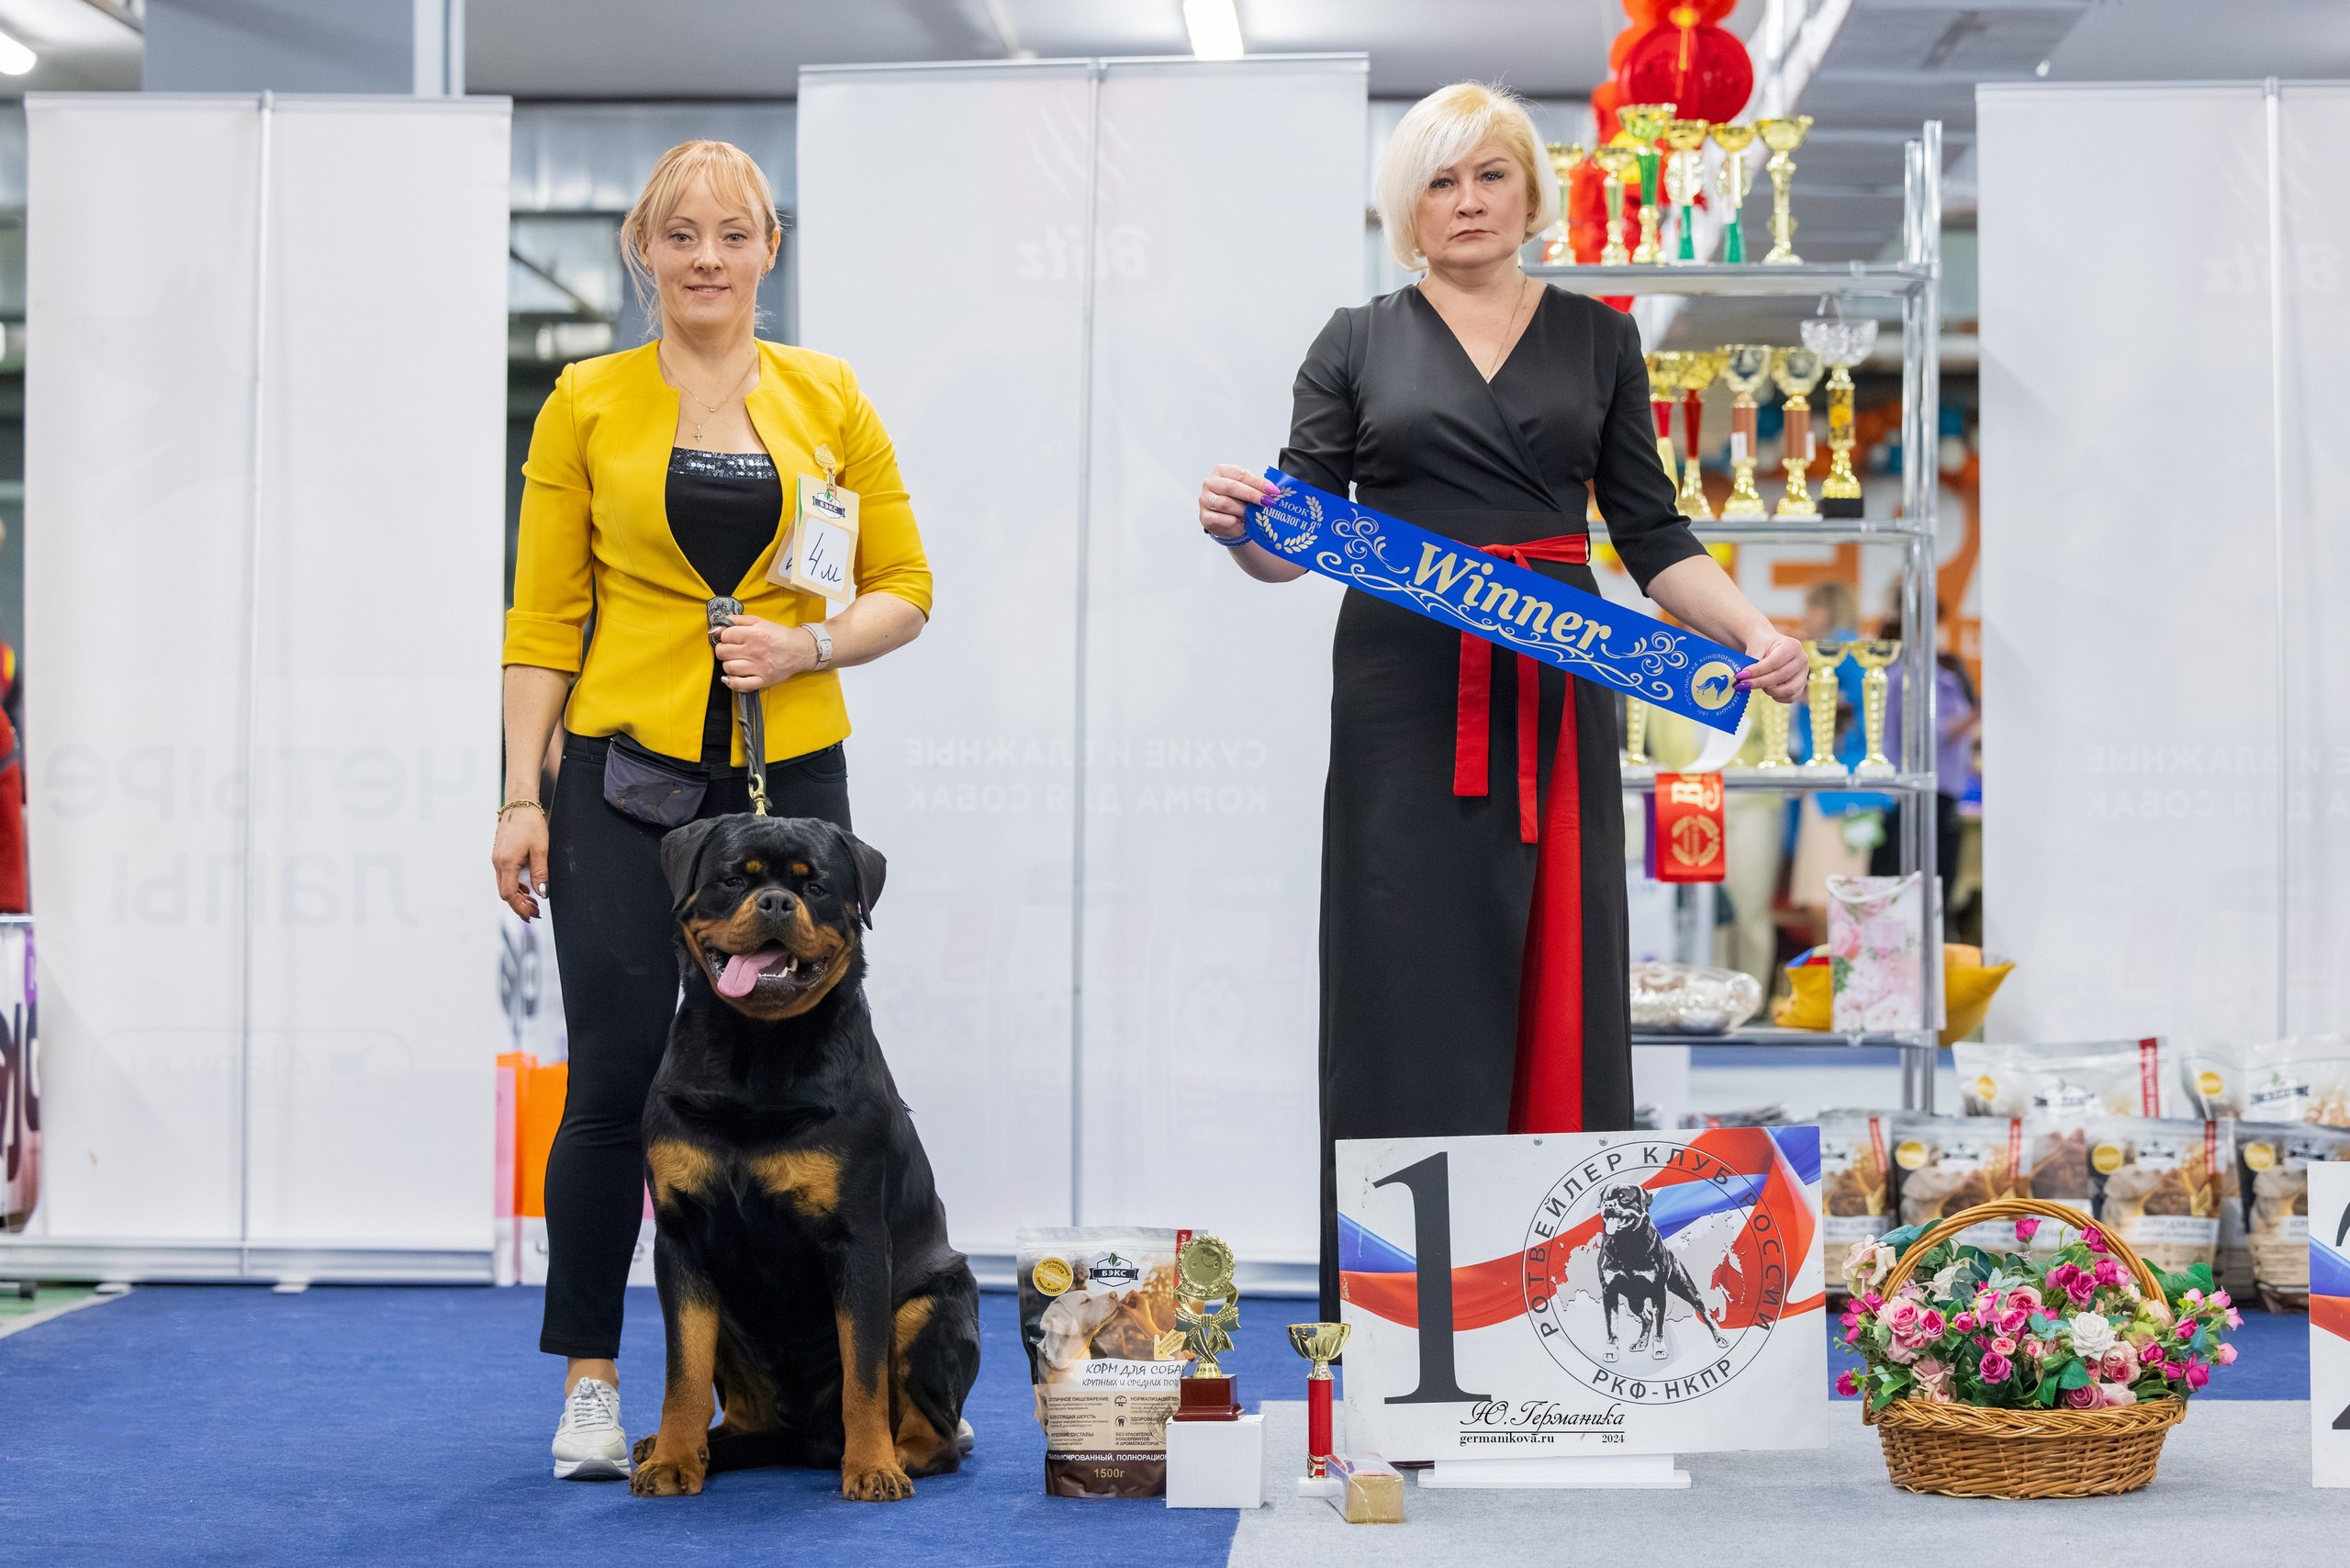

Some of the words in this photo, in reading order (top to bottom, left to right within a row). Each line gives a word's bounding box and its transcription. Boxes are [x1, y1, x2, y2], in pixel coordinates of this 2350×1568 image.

[1414, 542, 1612, 650] Winner
[1699, 654, 1740, 672] КИНОЛОГИЧЕС
[1528, 1152, 1623, 1338] РОТВЕЙЛЕР
[1643, 1146, 1729, 1186] КЛУБ
[1739, 1191, 1782, 1332] РОССИИ
[1372, 1151, 1492, 1405] 1
[1086, 1362, 1118, 1374] КОРМ
[1119, 1364, 1146, 1378] ДЛЯ
[1591, 1358, 1732, 1400] РКФ-НКПР
[1082, 1379, 1117, 1387] КРУПНЫХ
[1127, 1379, 1161, 1389] СРЕДНИХ
[1116, 1454, 1167, 1462] ПОЛНОРАЦИО
[1093, 1468, 1125, 1479] 1500г
